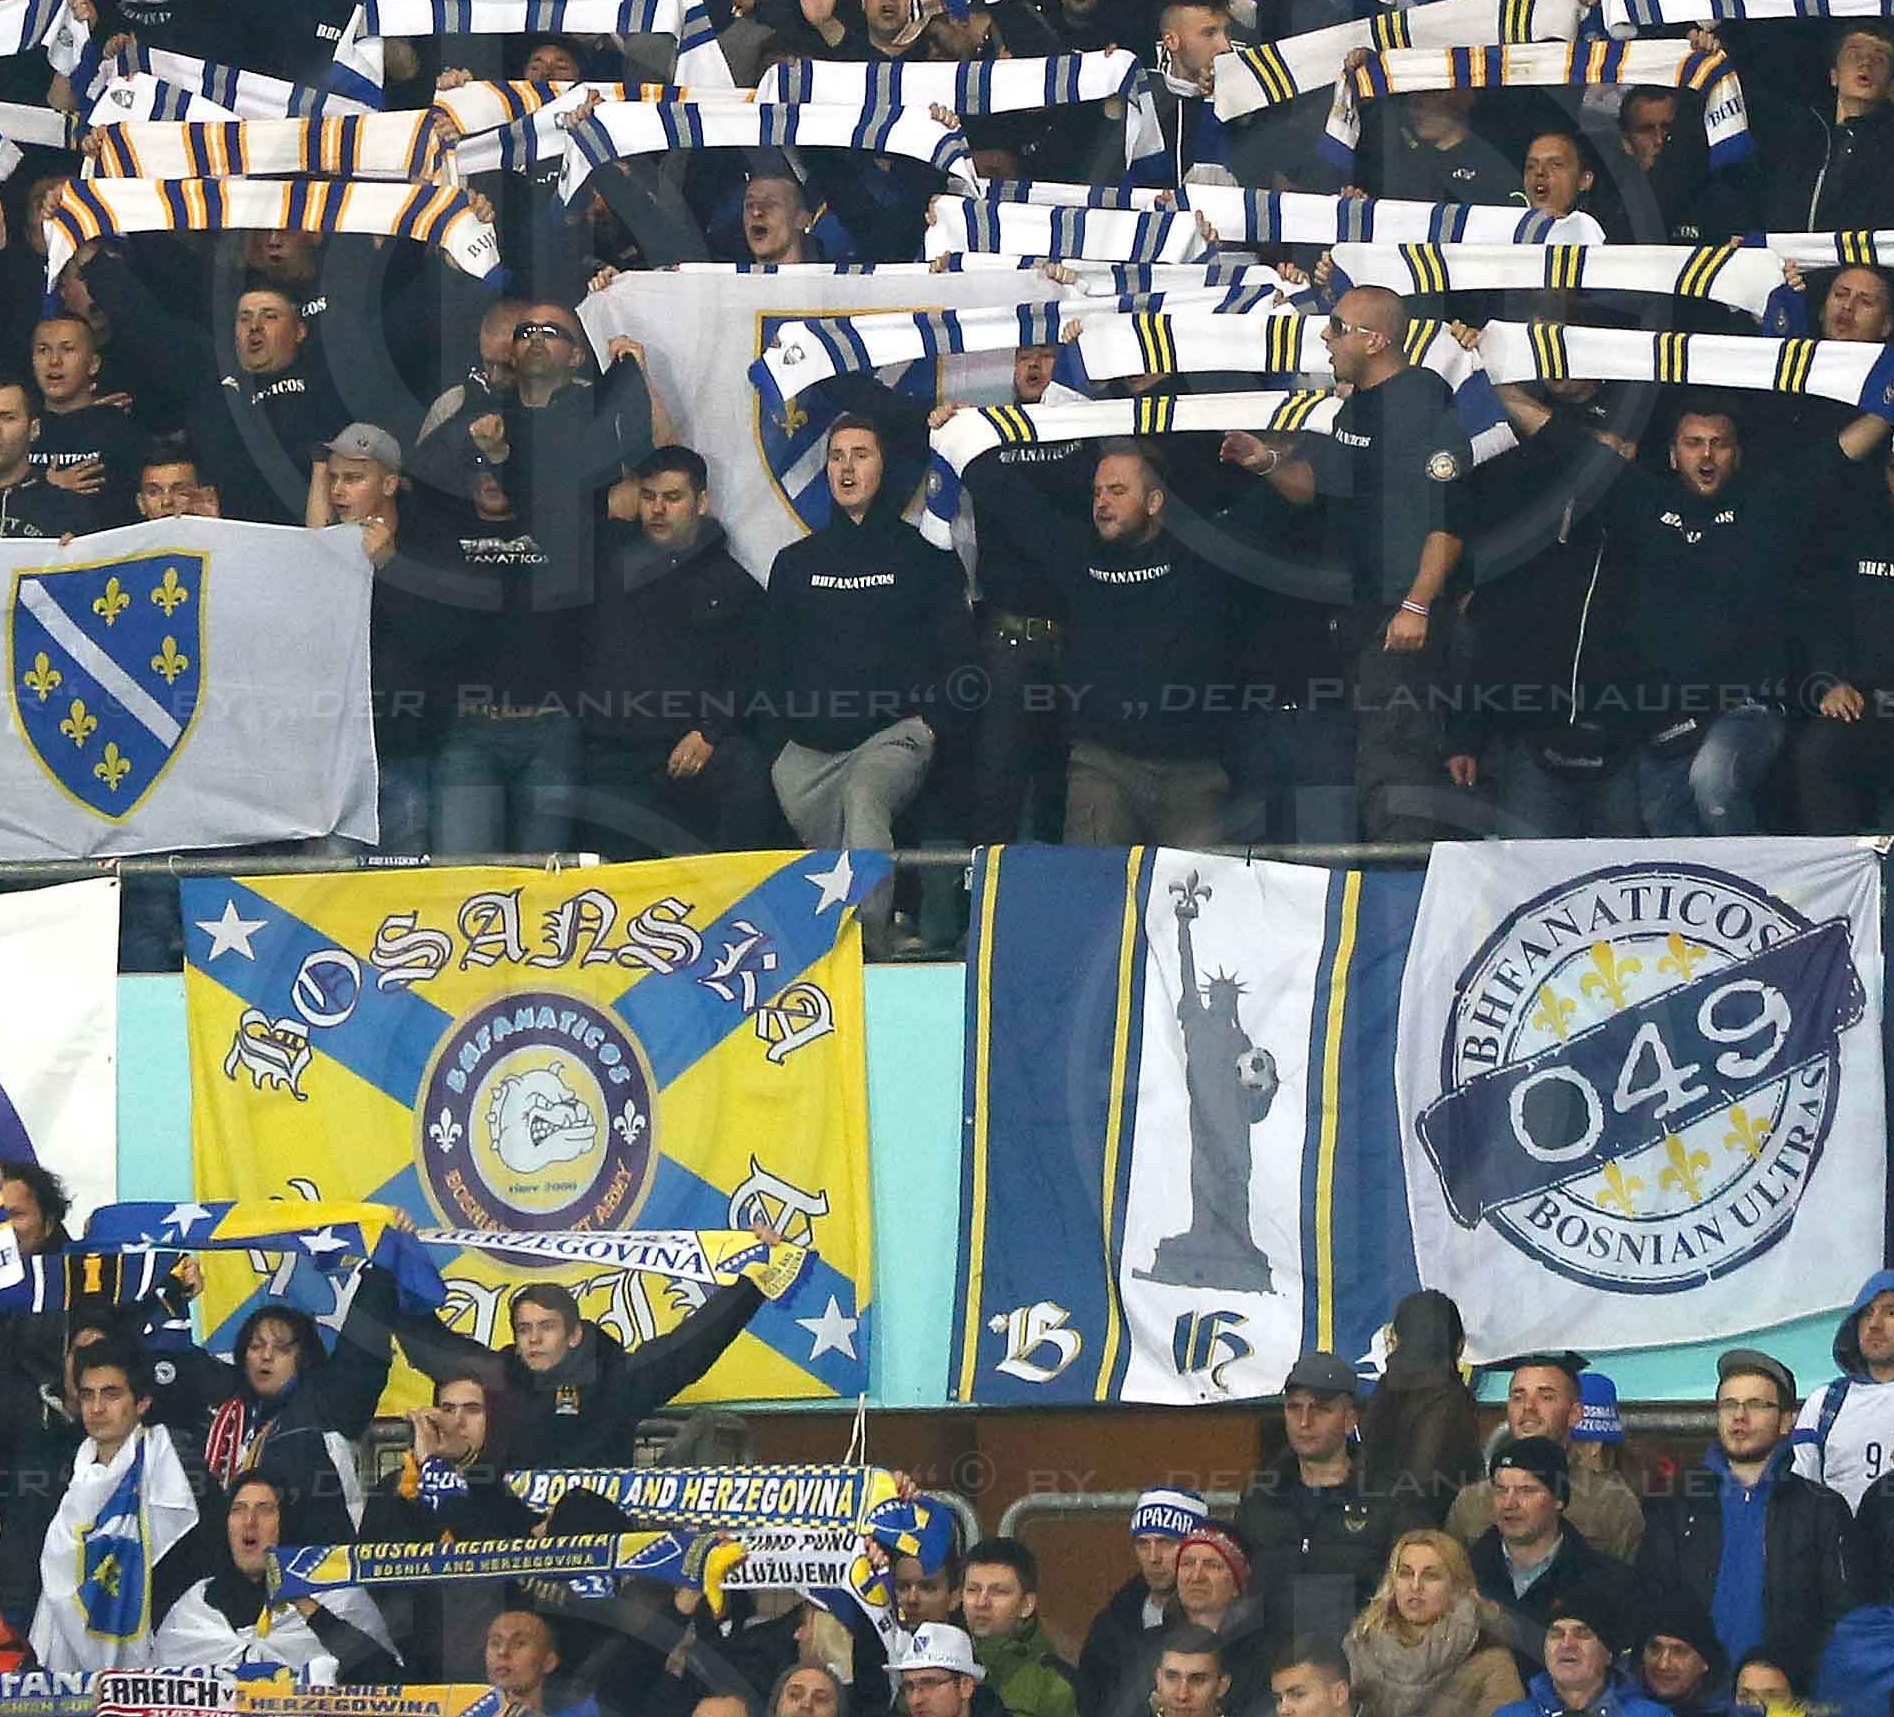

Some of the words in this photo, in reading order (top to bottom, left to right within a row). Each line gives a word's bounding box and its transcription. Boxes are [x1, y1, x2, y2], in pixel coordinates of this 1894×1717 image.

[1462, 885, 1783, 1065] BHFANATICOS
[1507, 977, 1793, 1164] 049
[1528, 1189, 1726, 1267] BOSNIAN
[1865, 1441, 1882, 1479] 9
[622, 1475, 680, 1509] AND
[681, 1474, 855, 1516] HERZEGOVINA
[99, 1672, 219, 1704] ERREICH
